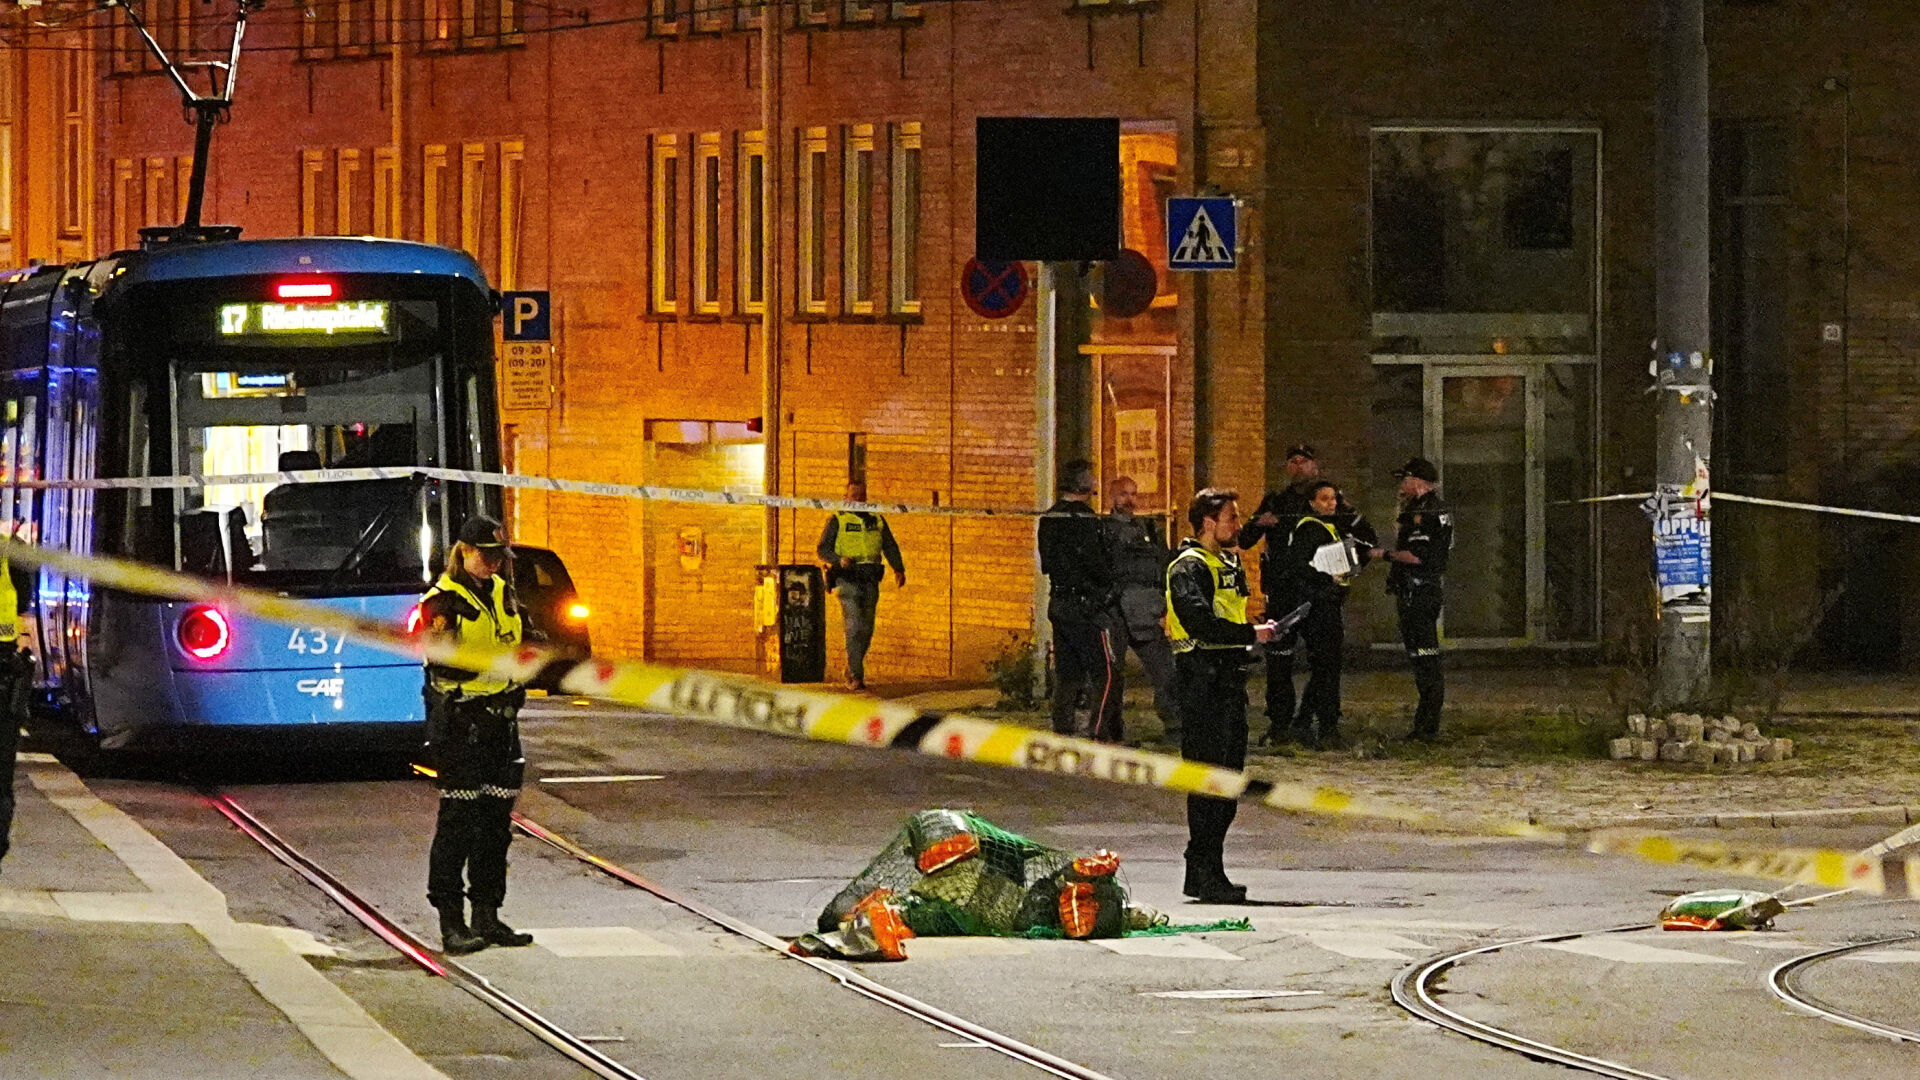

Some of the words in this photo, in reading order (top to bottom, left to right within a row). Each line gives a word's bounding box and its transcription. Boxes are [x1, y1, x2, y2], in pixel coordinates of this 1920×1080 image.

[222, 304, 248, 334] 17
[514, 297, 539, 335] P
[297, 679, 345, 697] CAF
[1026, 740, 1157, 785] POLITI
